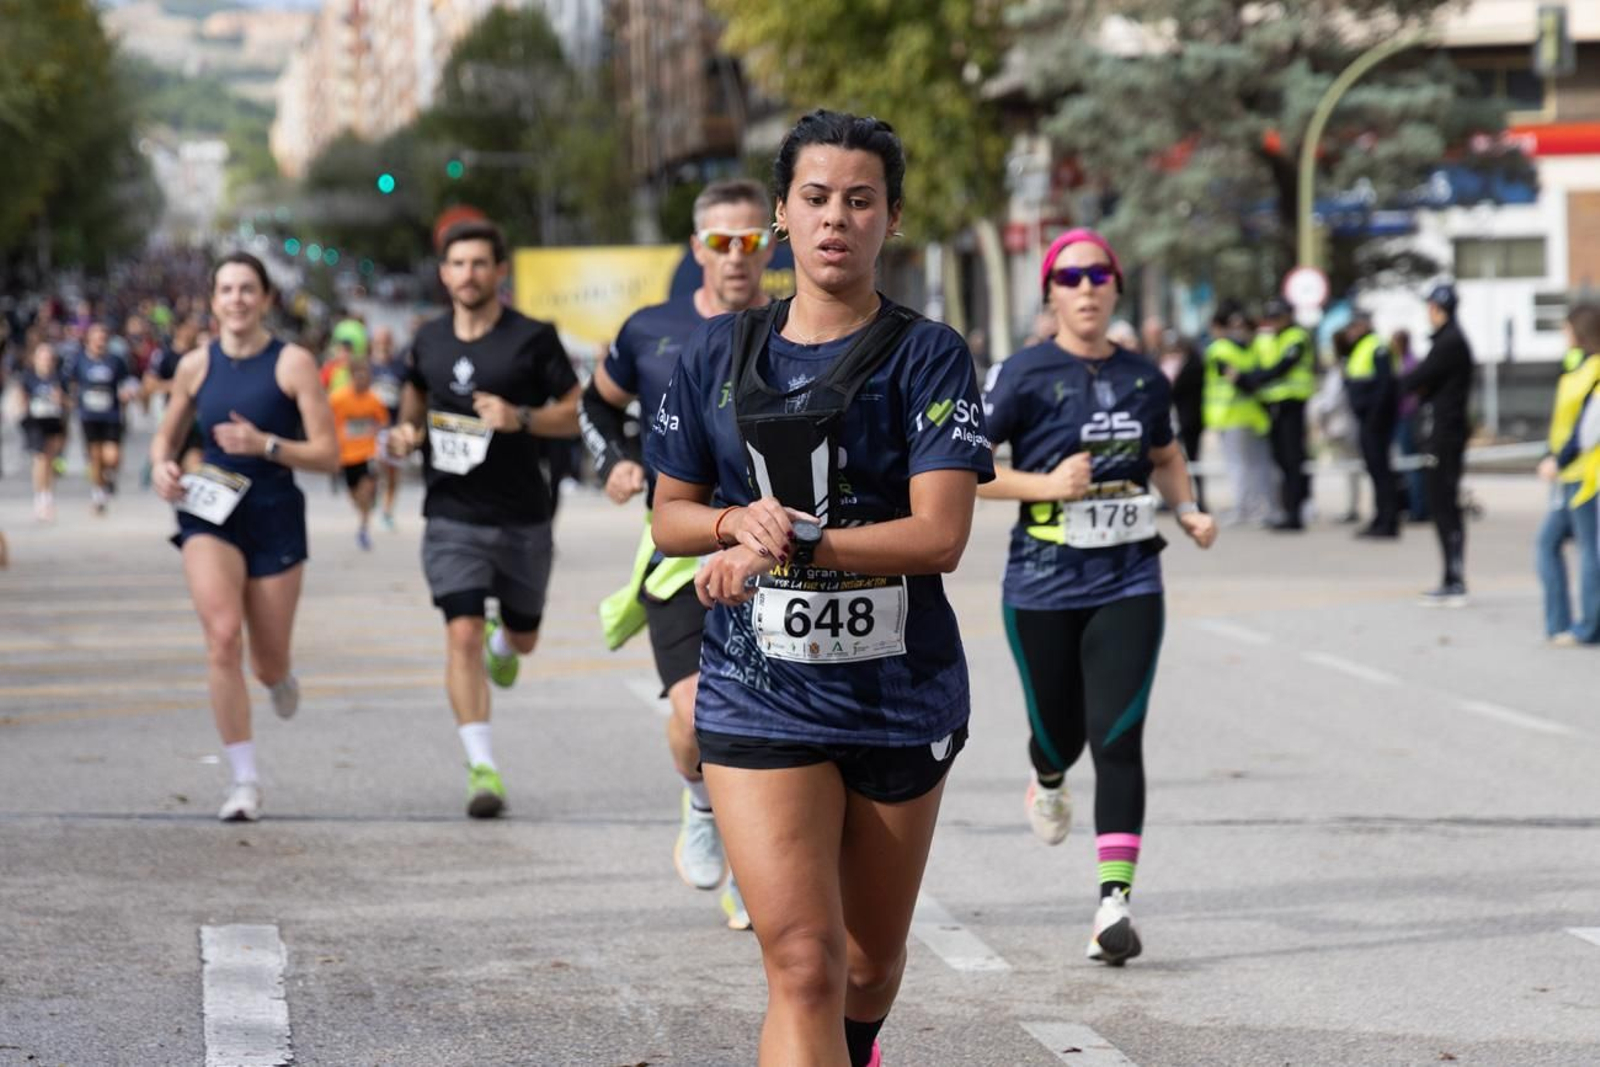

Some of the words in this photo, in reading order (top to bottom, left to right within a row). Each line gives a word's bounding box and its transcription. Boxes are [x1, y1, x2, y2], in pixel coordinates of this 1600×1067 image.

[1080, 411, 1143, 442] 25
[1085, 504, 1138, 528] 178
[806, 567, 838, 579] gran
[784, 596, 875, 638] 648
